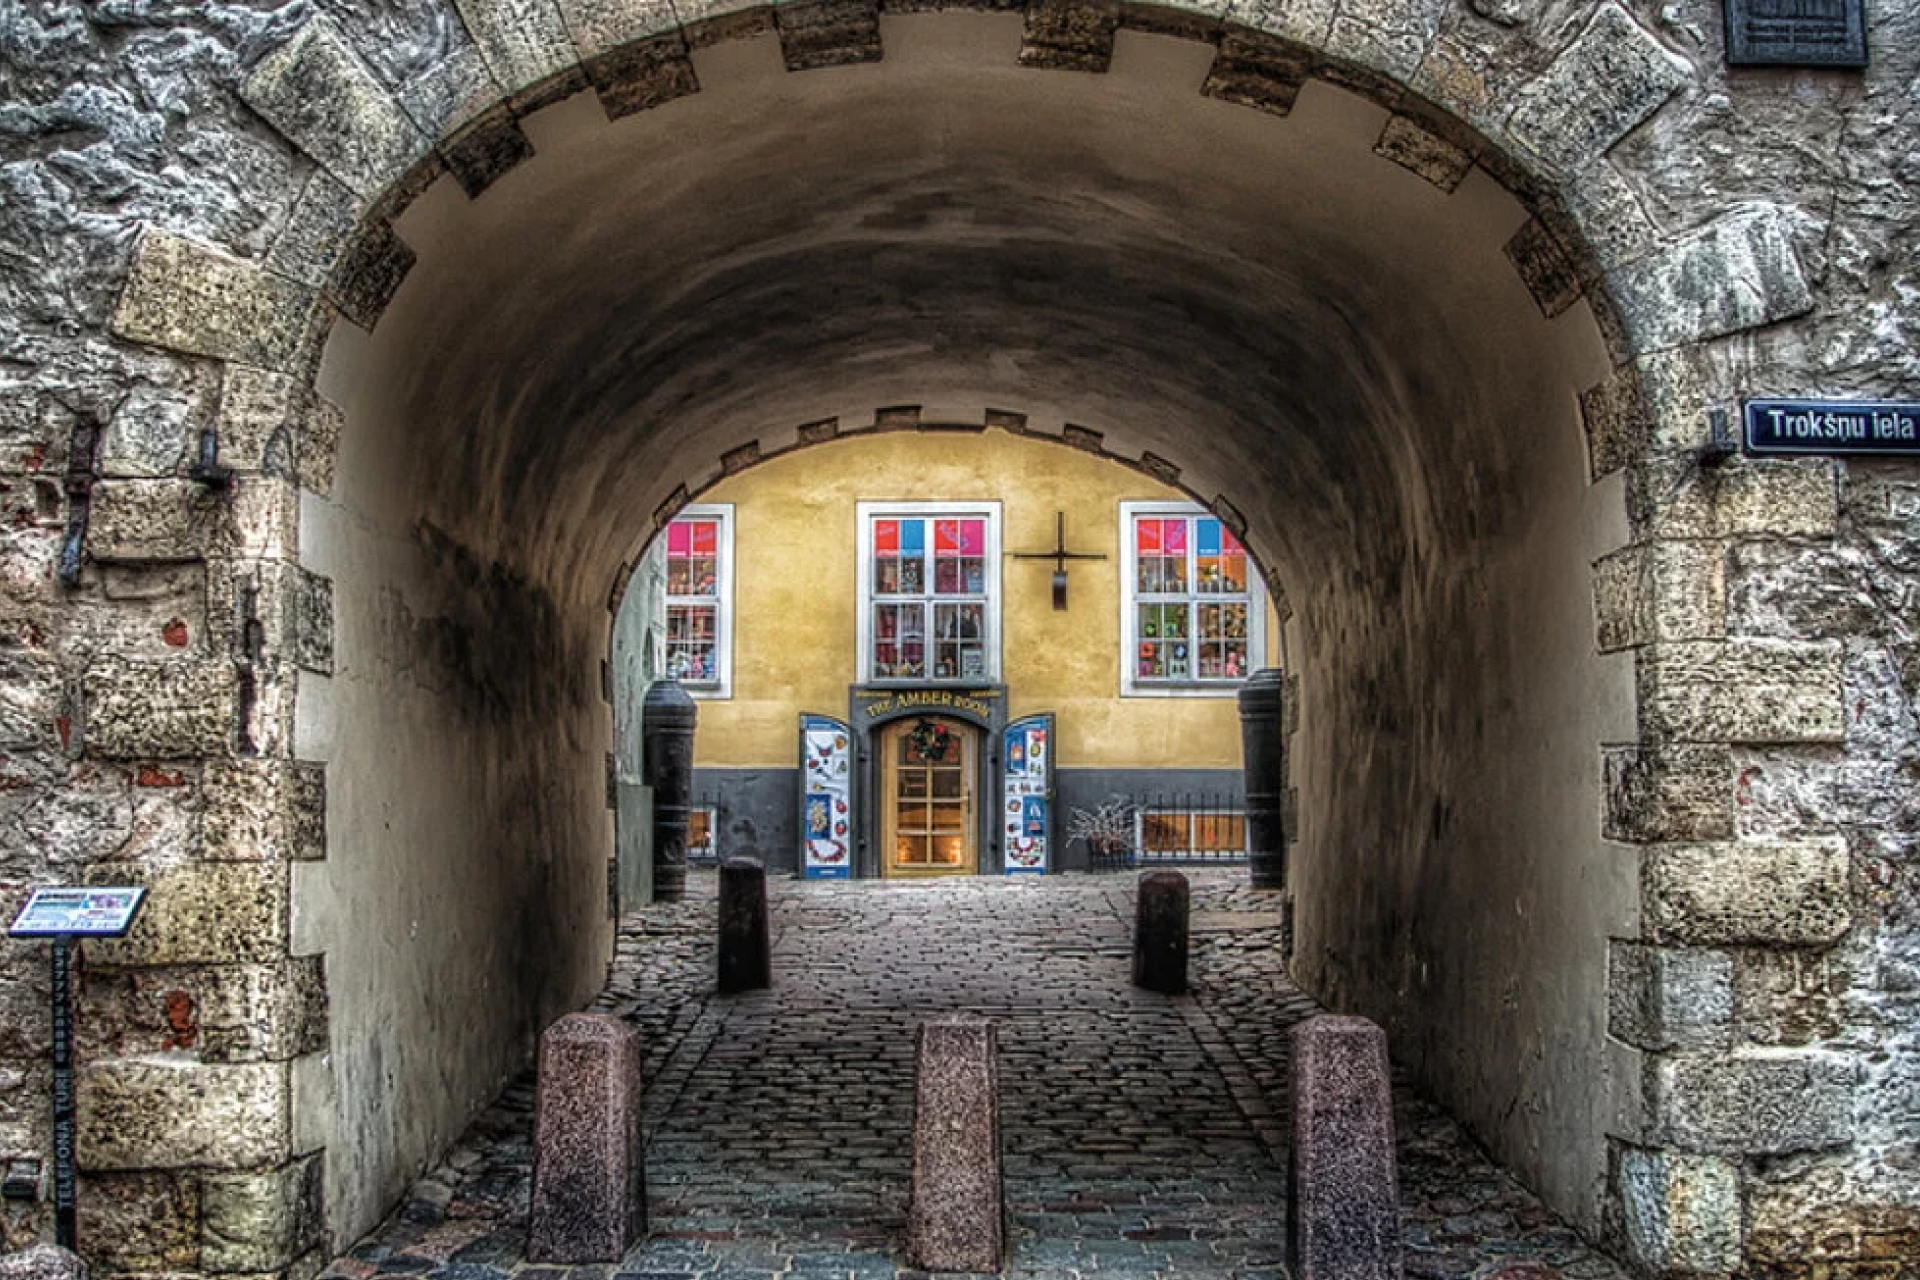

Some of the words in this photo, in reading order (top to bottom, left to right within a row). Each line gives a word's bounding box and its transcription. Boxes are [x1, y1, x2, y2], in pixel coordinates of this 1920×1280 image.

[1767, 409, 1866, 442] Trokšņu
[1871, 411, 1915, 439] iela
[866, 699, 893, 718] THE
[897, 689, 953, 708] AMBER
[953, 695, 991, 719] ROOM
